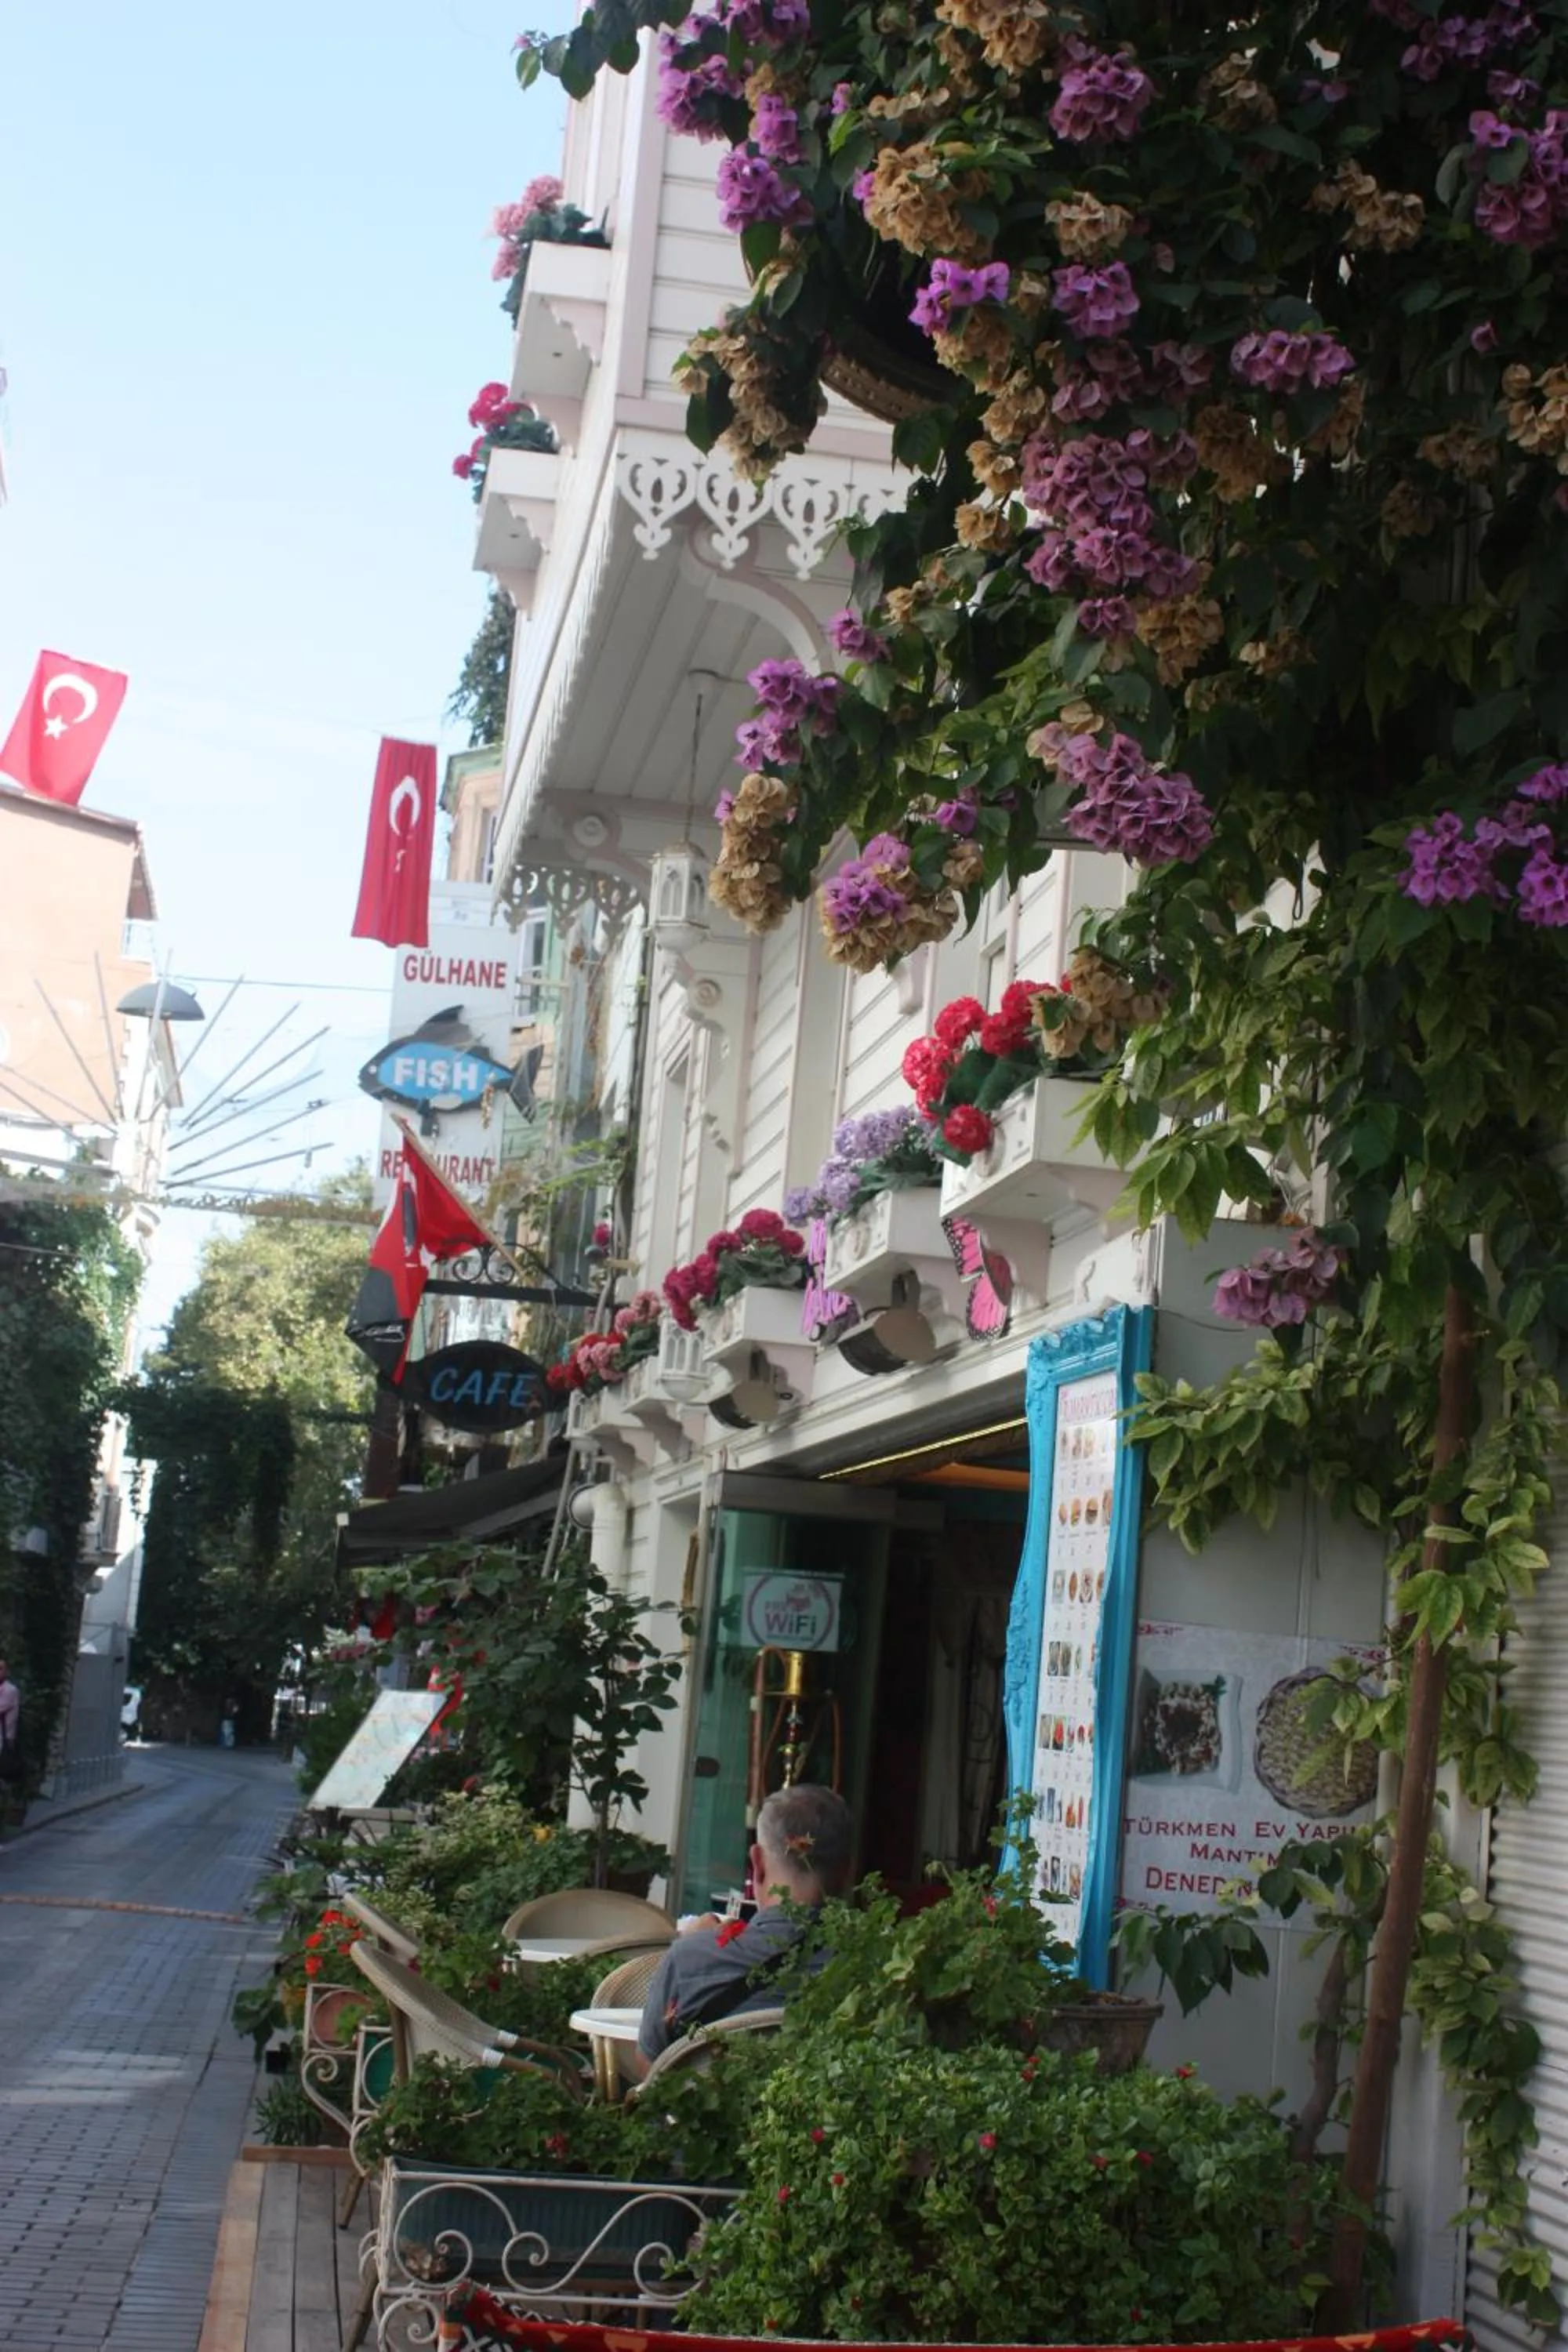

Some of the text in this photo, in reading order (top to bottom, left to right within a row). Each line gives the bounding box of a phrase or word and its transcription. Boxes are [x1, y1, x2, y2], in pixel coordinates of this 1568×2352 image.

[403, 950, 507, 989] GÜLHANE
[394, 1058, 478, 1091] FISH
[432, 1368, 536, 1406] CAFE
[1123, 1816, 1236, 1837] TÜRKMEN
[1255, 1822, 1286, 1838] EV
